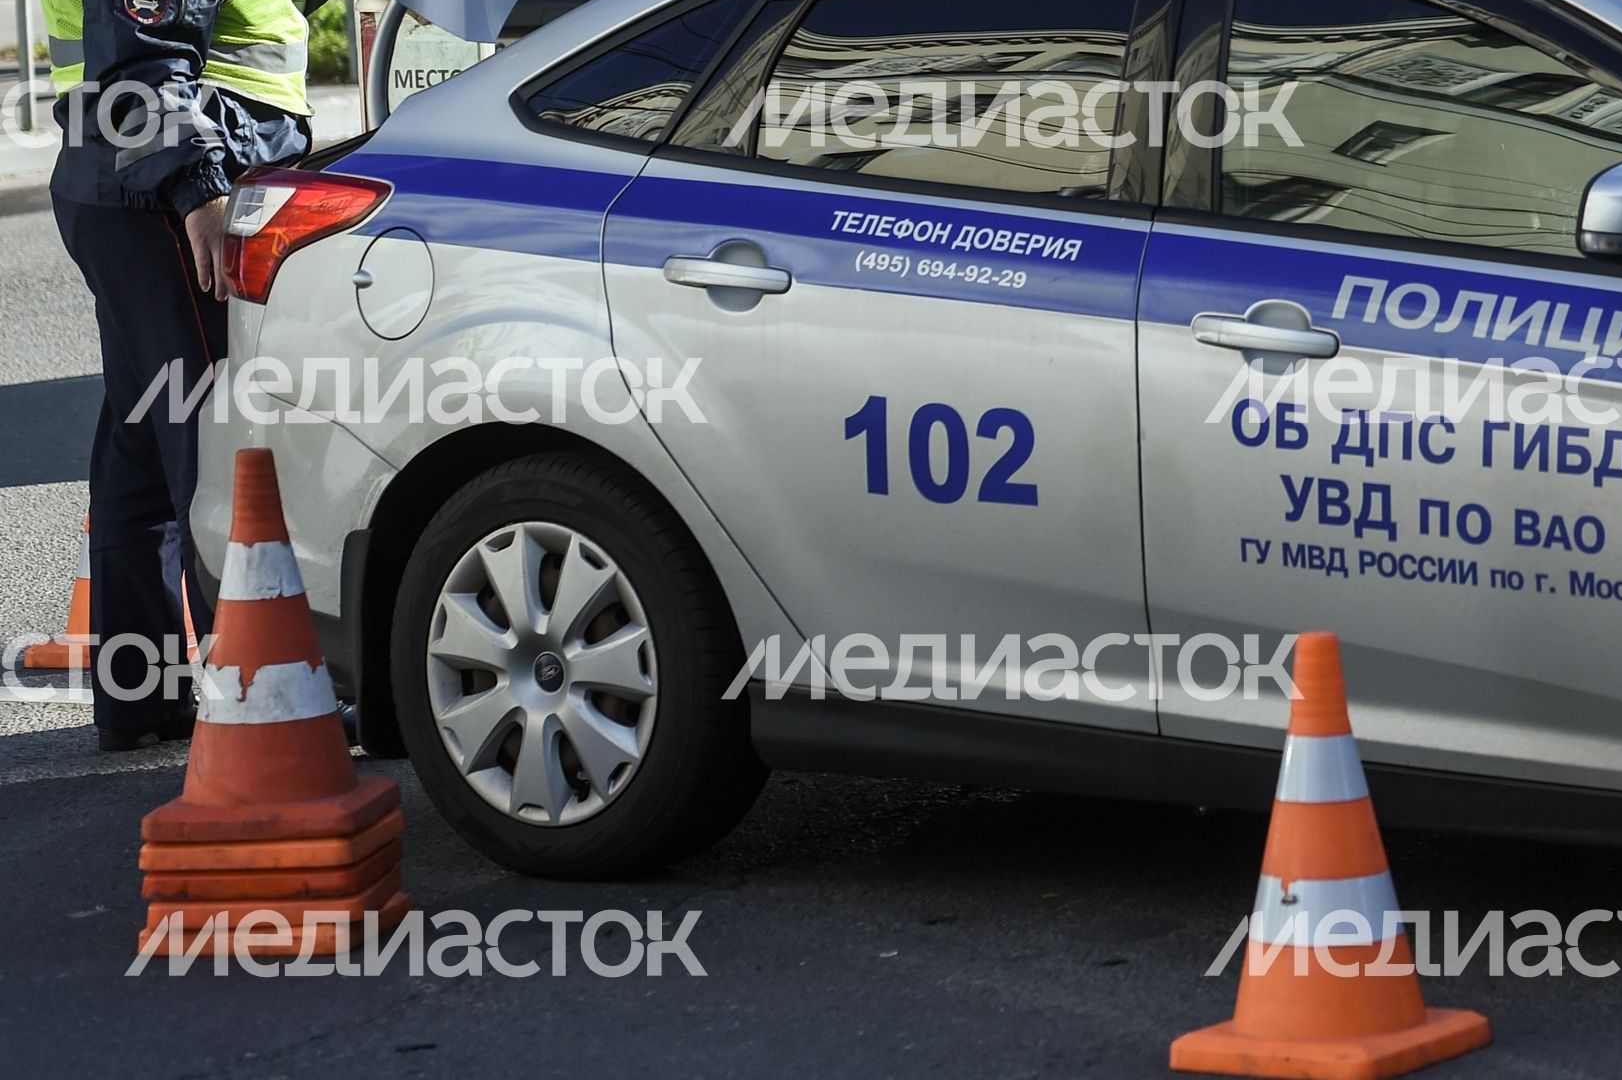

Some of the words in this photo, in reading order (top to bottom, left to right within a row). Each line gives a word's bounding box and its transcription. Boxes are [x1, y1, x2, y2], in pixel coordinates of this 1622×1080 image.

[394, 69, 462, 89] МЕСТ
[830, 210, 953, 246] ТЕЛЕФОН
[950, 225, 1083, 262] ДОВЕРИЯ
[854, 251, 911, 278] (495)
[916, 259, 1028, 289] 694-92-29
[844, 395, 1039, 506] 102
[1231, 398, 1309, 451] ОБ
[1331, 407, 1456, 468] ДПС
[1279, 474, 1398, 542] УВД
[1513, 508, 1606, 555] ВАО
[1240, 537, 1272, 565] ГУ
[1281, 541, 1349, 579] МВД
[1358, 549, 1478, 587] РОССИИ
[1490, 568, 1525, 591] по
